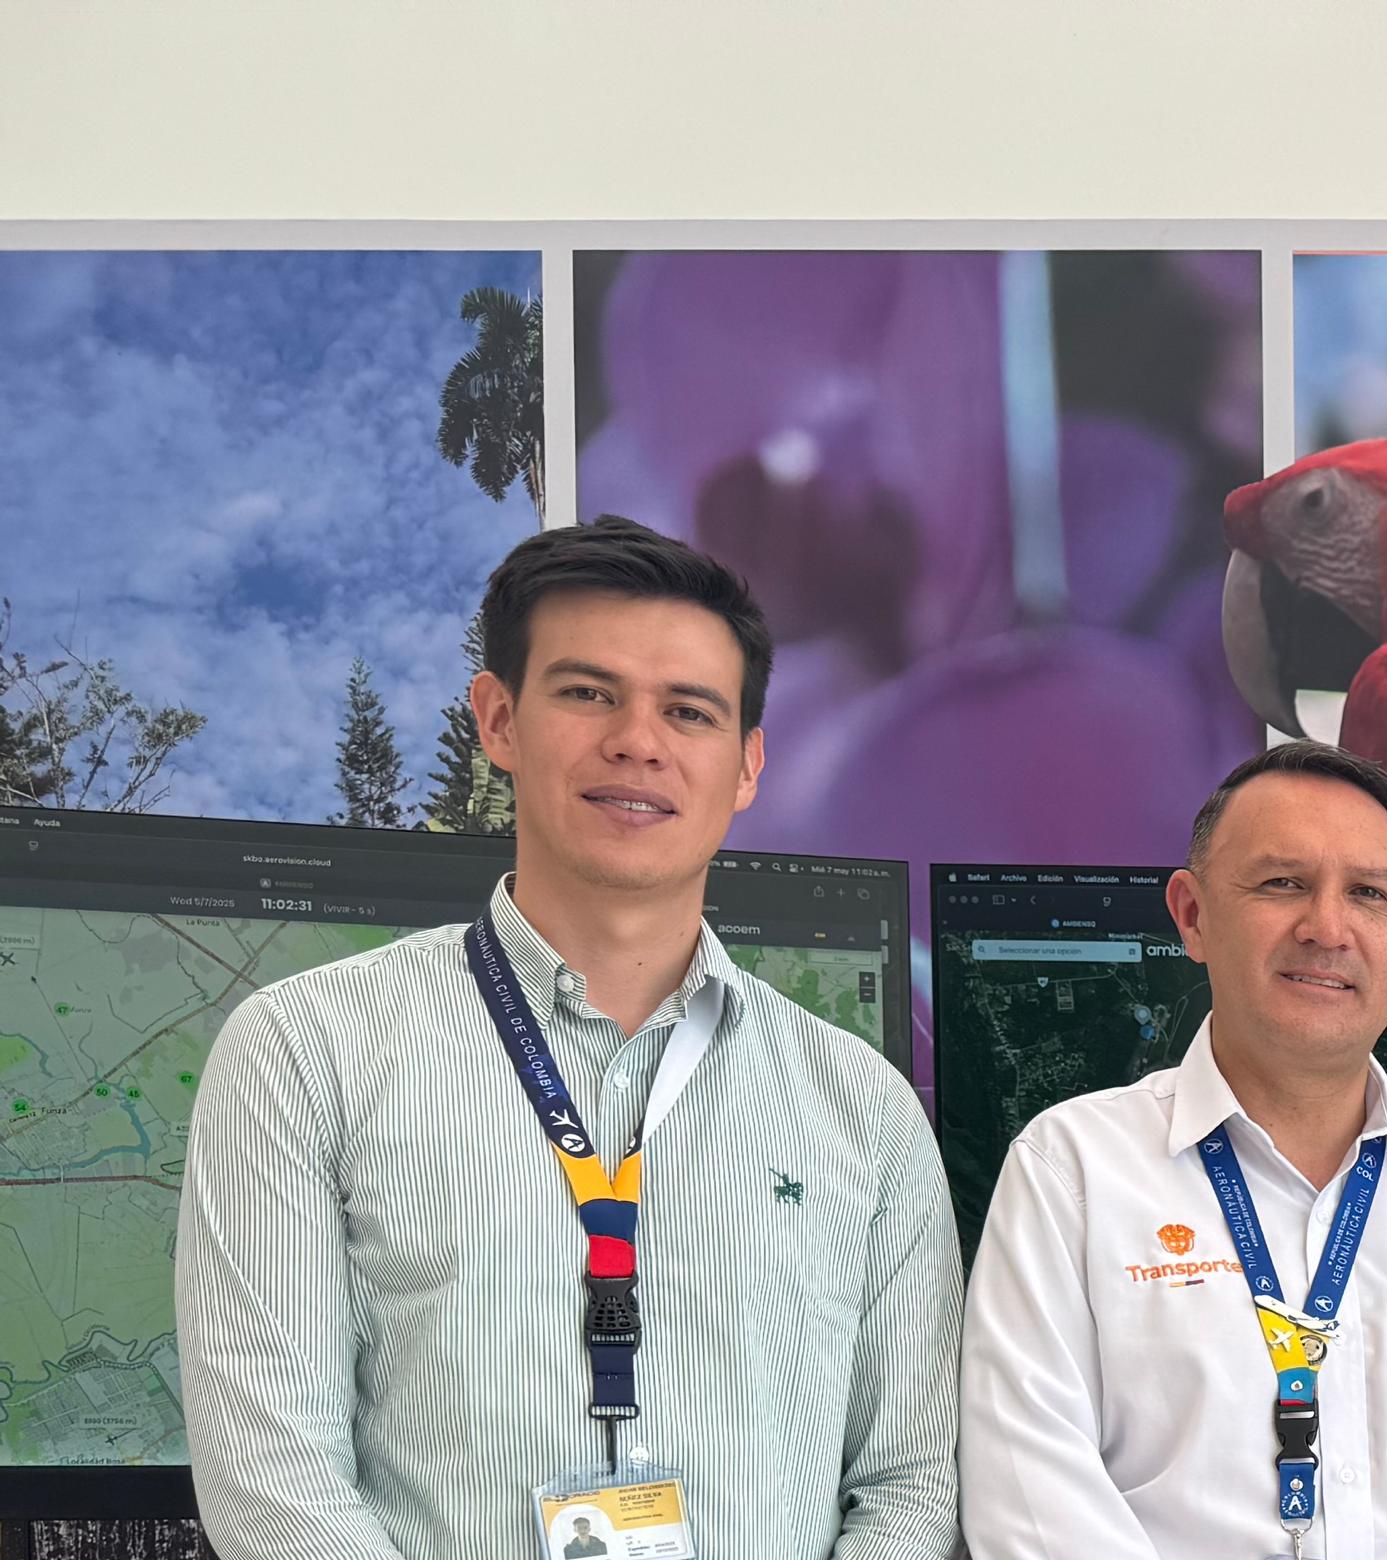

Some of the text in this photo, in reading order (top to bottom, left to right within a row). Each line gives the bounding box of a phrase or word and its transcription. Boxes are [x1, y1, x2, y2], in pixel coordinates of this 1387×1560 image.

[0, 817, 61, 828] tana Ayuda
[1000, 874, 1027, 882] Archivo
[1037, 874, 1064, 883] Edición
[1074, 875, 1119, 884] Visualización
[1129, 876, 1159, 885] Historial
[261, 897, 313, 911] 11:02:31
[718, 924, 761, 935] acoem
[999, 946, 1041, 955] Seleccionar
[1146, 943, 1190, 957] ambi
[495, 983, 513, 1015] CIVIL
[510, 1016, 527, 1034] DE
[519, 1036, 557, 1099] COLOMBIA
[1354, 1187, 1370, 1214] CIVIL
[1240, 1241, 1257, 1269] CIVIL
[1125, 1259, 1244, 1282] Transporte
